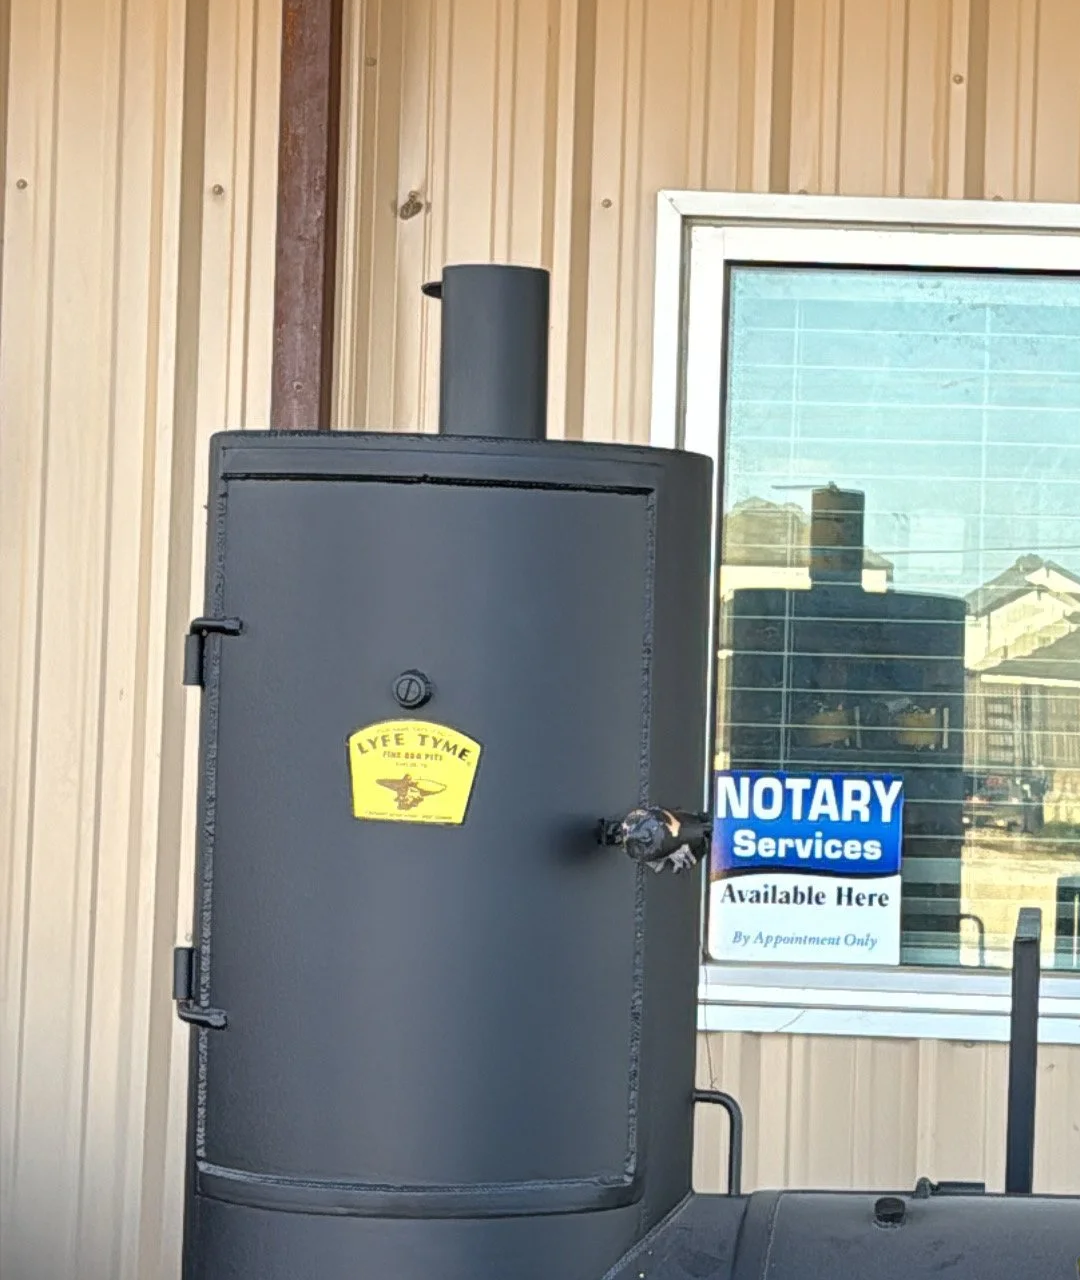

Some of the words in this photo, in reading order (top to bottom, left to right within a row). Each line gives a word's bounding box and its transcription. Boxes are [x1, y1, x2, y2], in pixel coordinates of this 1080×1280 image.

[357, 732, 405, 755] LYFE
[418, 733, 471, 761] TYME
[716, 776, 903, 822] NOTARY
[733, 828, 882, 860] Services
[720, 883, 826, 906] Available
[836, 886, 889, 907] Here
[732, 930, 750, 946] By
[753, 930, 841, 949] Appointment
[844, 932, 878, 950] Only
